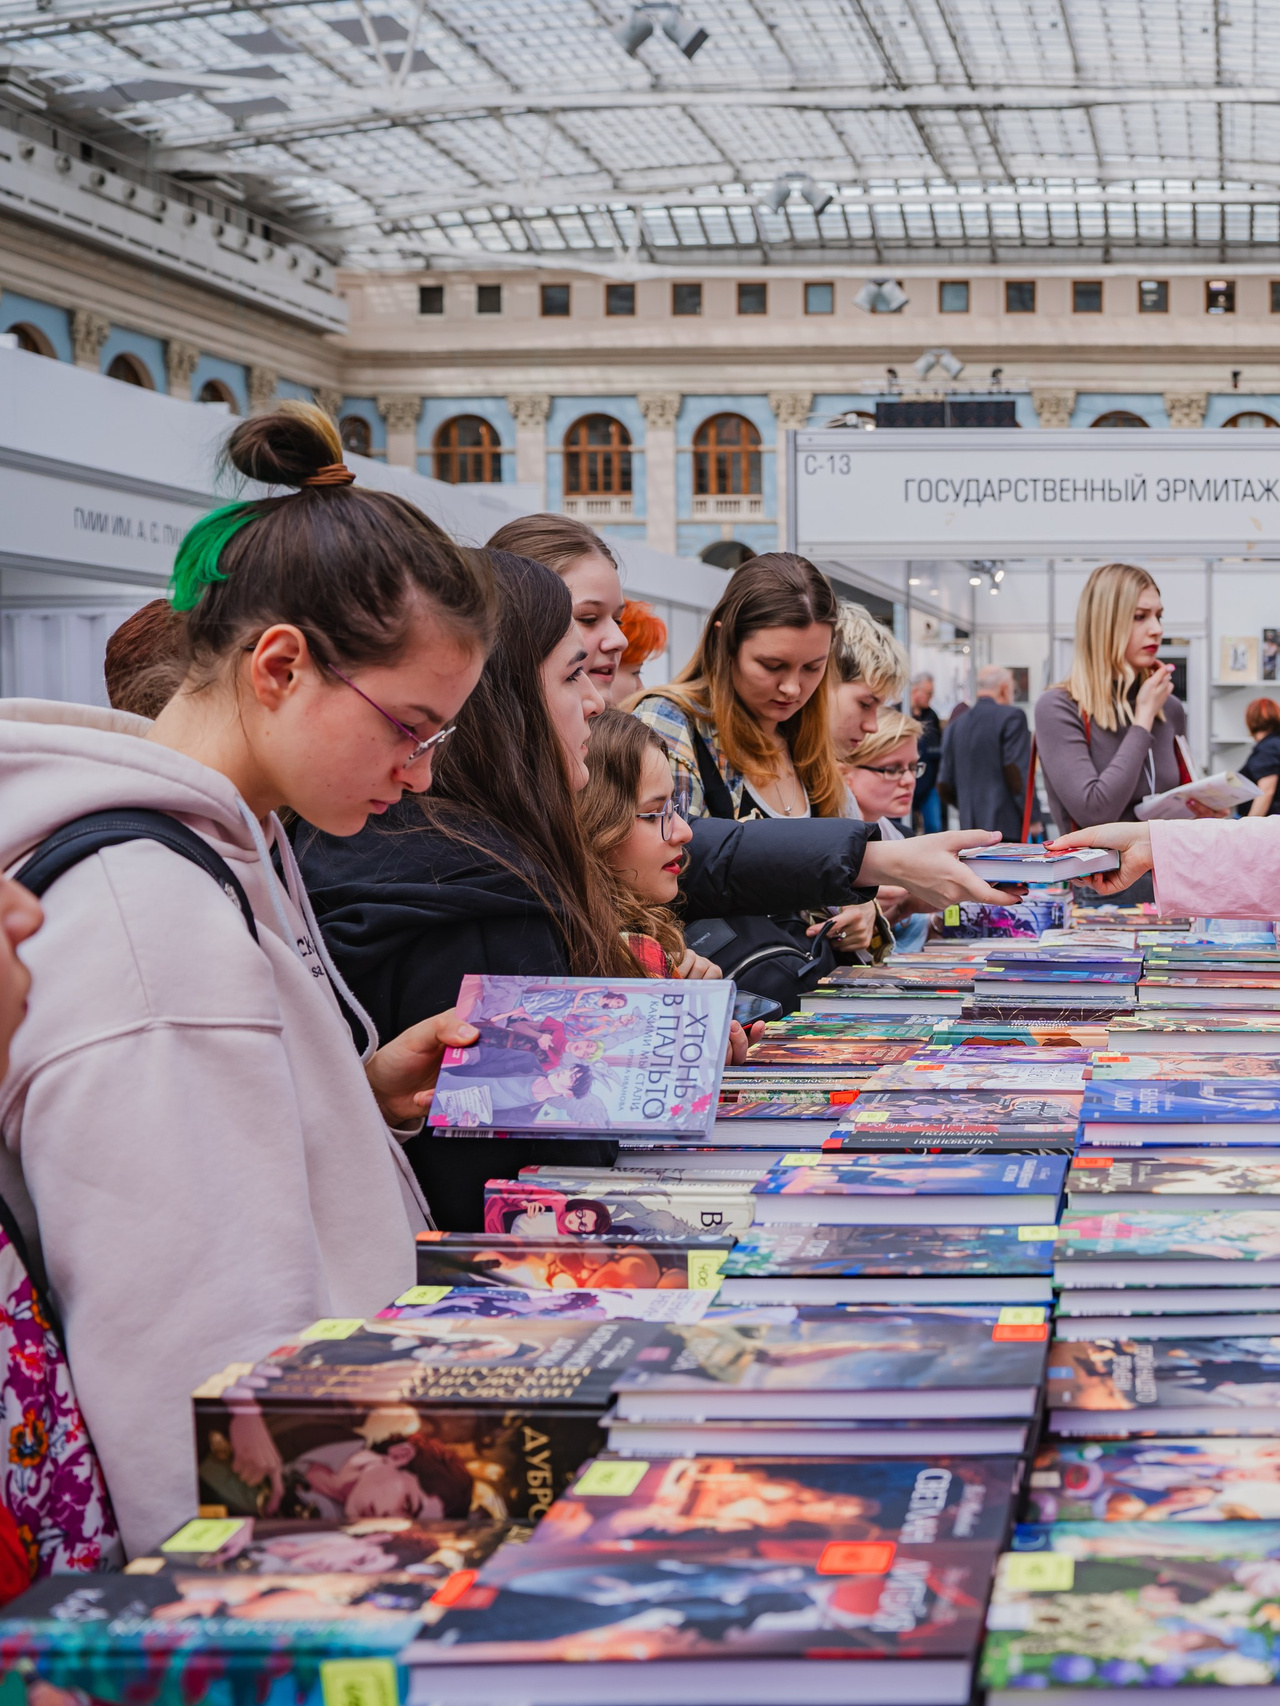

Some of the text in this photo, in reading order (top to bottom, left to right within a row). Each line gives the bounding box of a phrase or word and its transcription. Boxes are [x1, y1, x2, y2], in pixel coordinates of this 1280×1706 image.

[903, 473, 1280, 507] ГОСУДАРСТВЕННЫЙ ЭРМИТАЖ
[642, 1000, 660, 1048] КАКИМИ
[641, 993, 685, 1120] В ПАЛЬТО
[672, 1011, 710, 1099] ХТОНЬ
[629, 1072, 647, 1112] СТАЛИ
[700, 1211, 723, 1228] В
